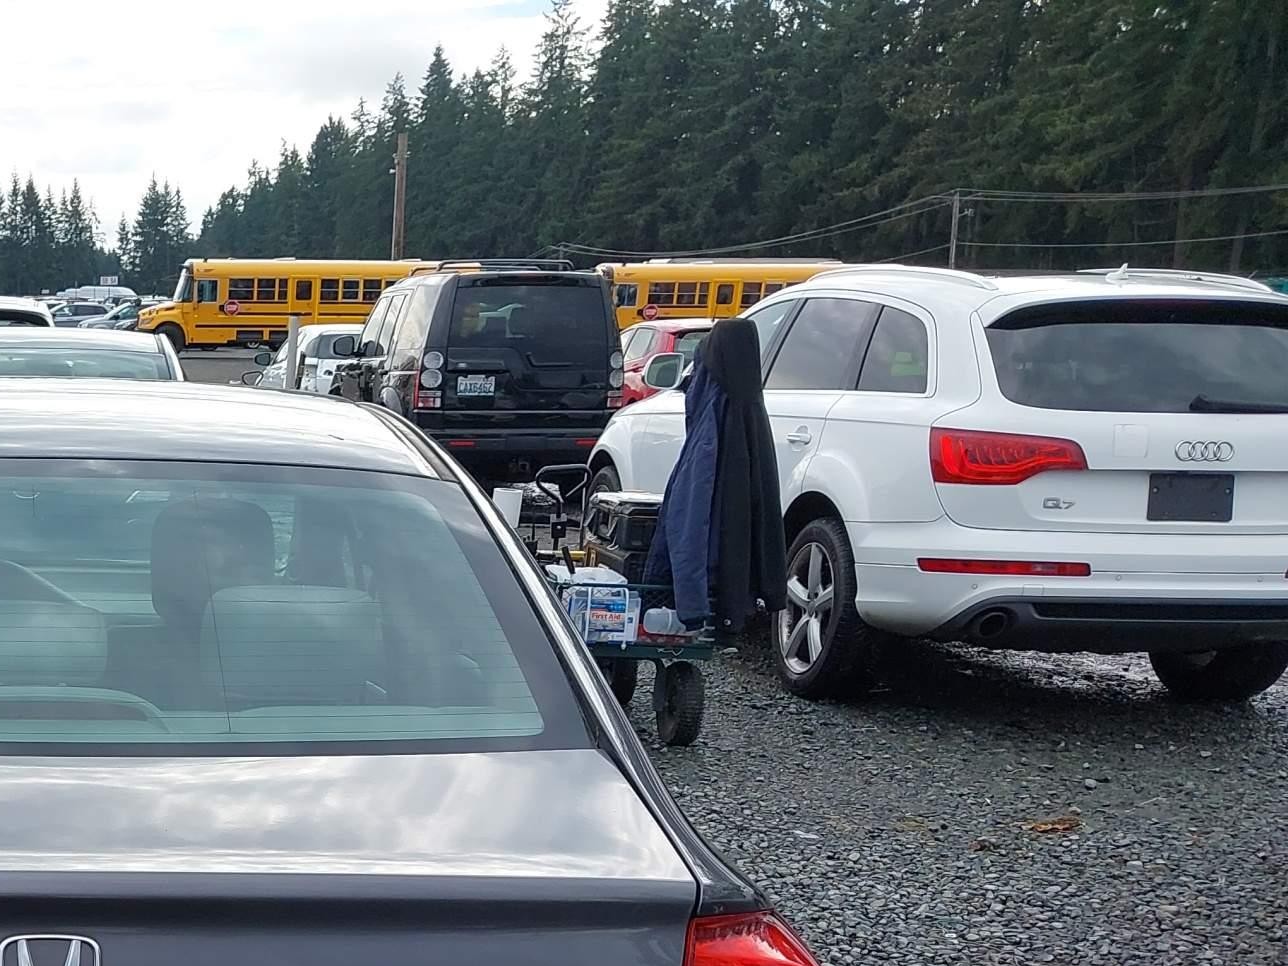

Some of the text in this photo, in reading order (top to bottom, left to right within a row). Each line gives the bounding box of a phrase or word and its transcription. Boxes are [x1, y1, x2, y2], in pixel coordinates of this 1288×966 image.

[1042, 497, 1076, 510] Q7
[592, 612, 622, 621] First Aid
